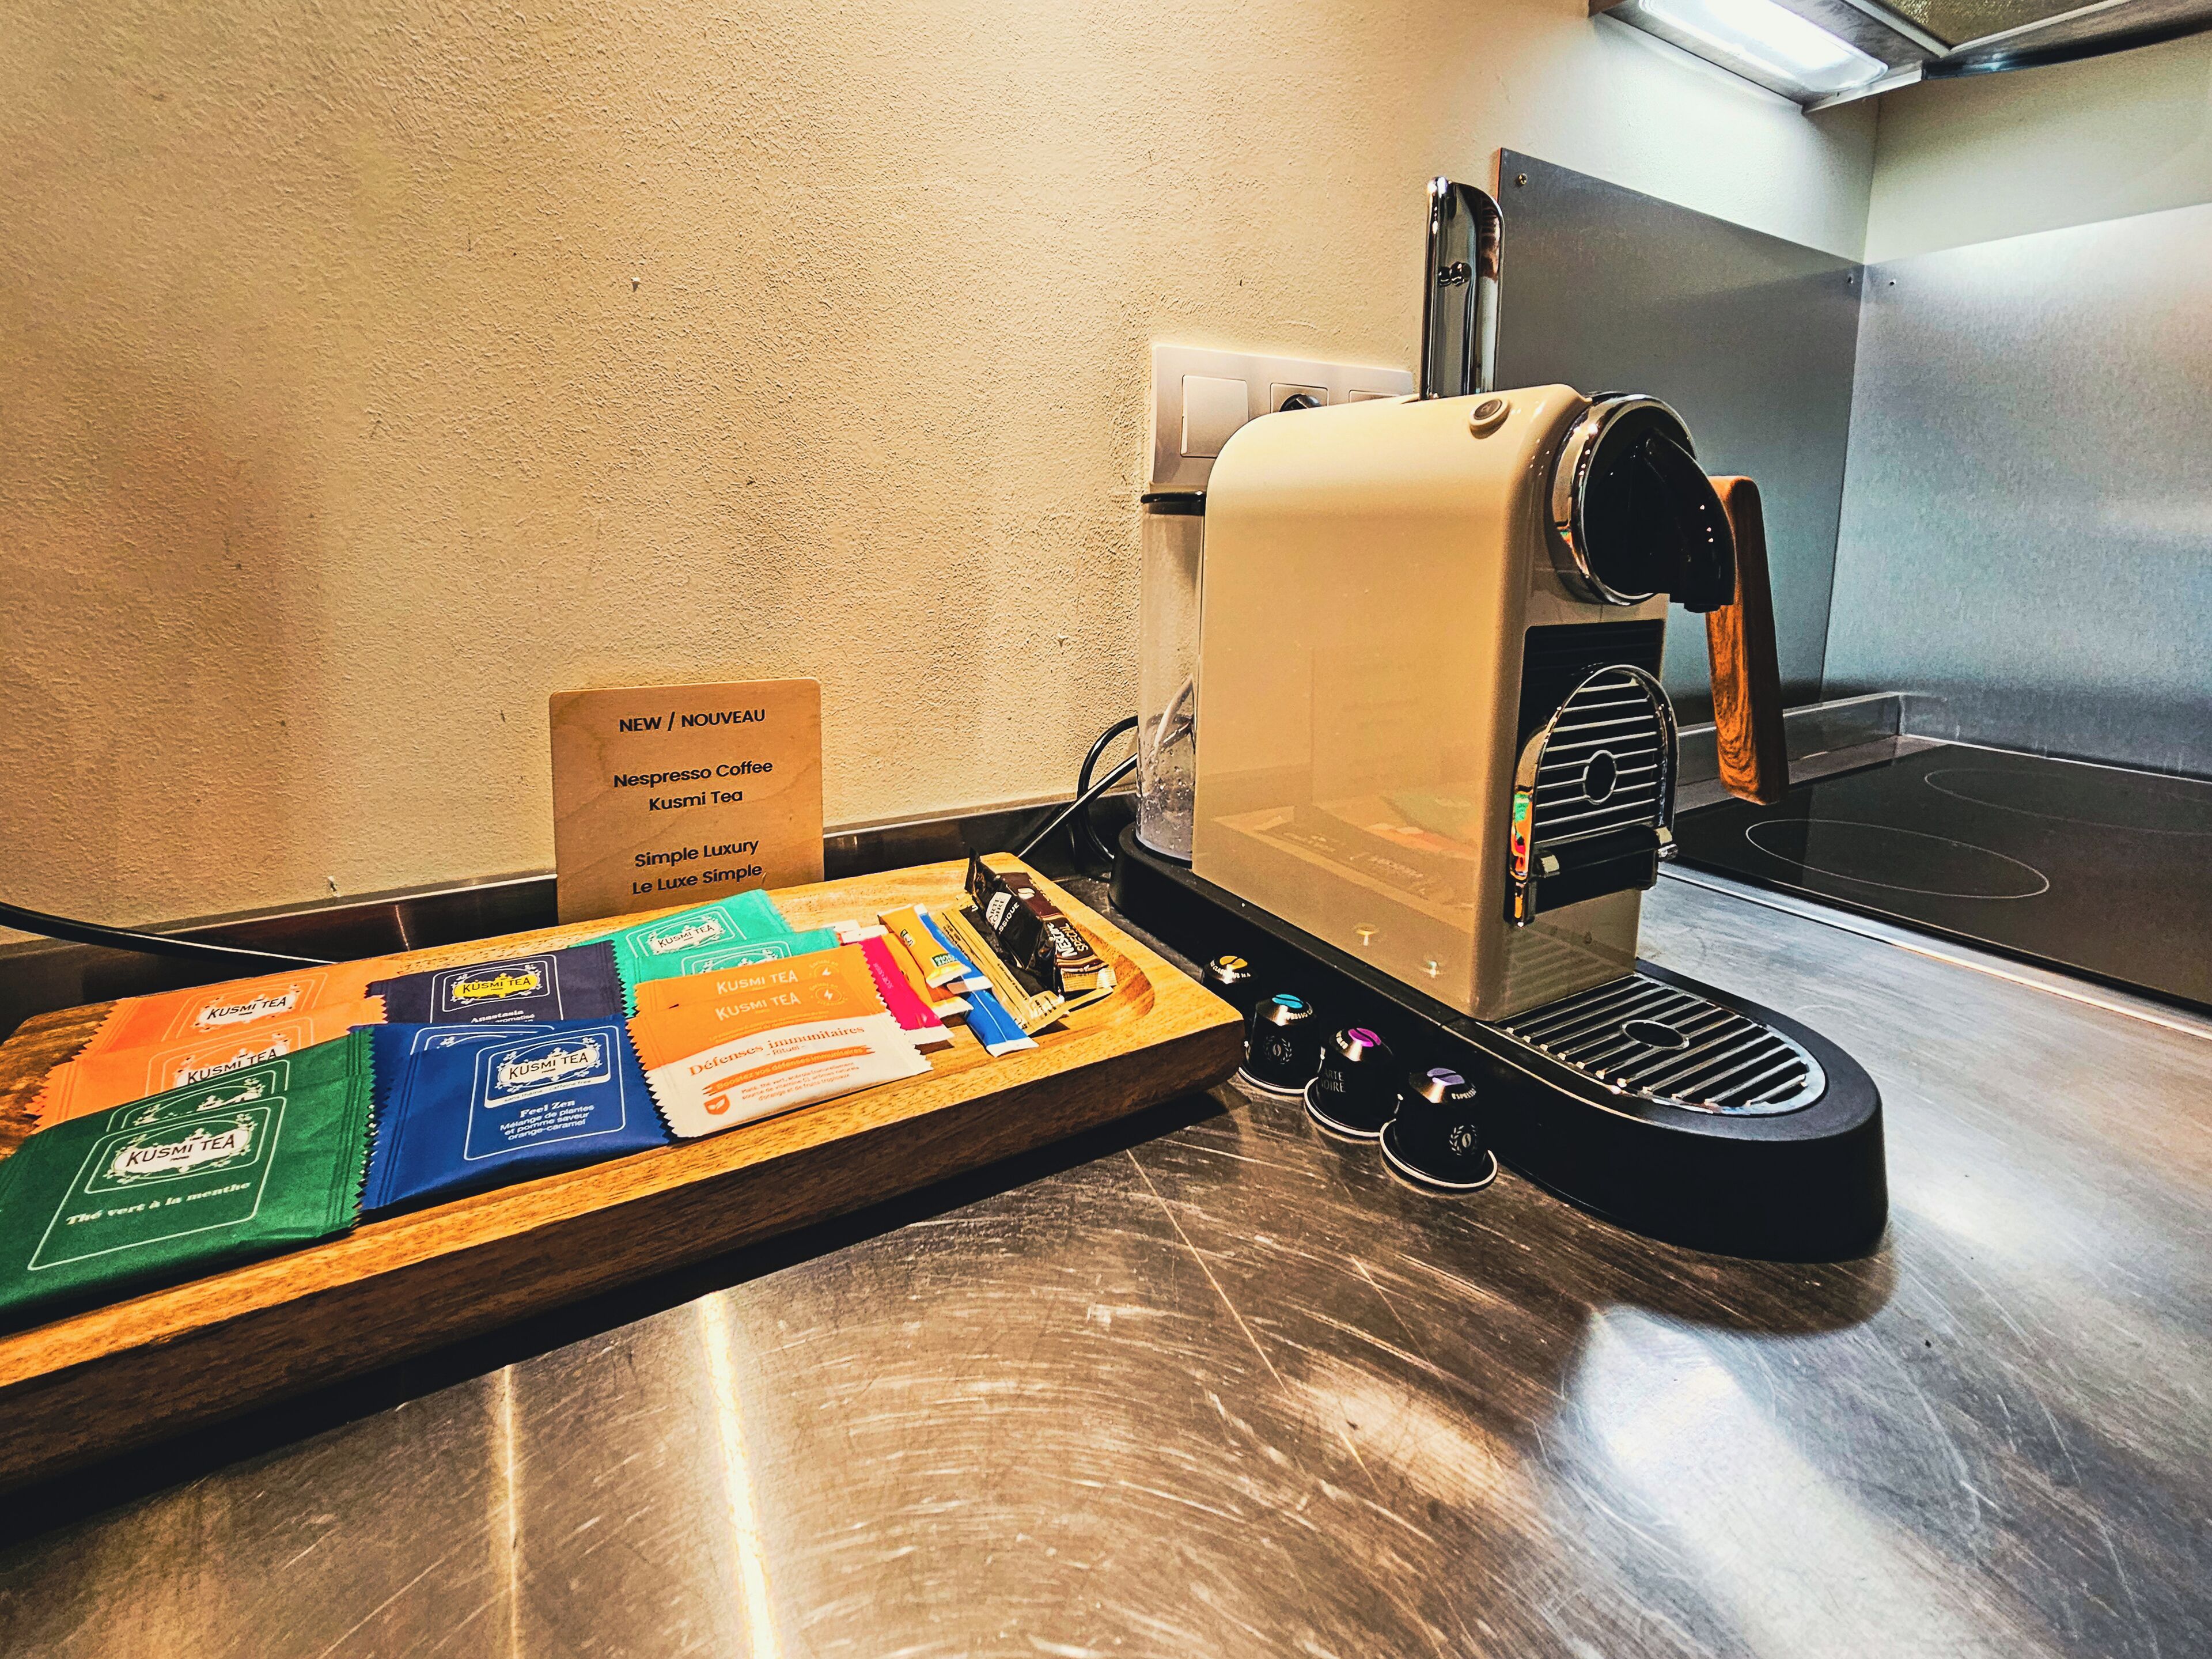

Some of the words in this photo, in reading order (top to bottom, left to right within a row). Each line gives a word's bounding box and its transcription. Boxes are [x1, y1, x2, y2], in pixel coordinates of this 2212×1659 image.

[619, 717, 662, 732] NEW
[667, 711, 675, 731] /
[681, 709, 766, 728] NOUVEAU
[613, 768, 712, 788] Nespresso
[716, 760, 773, 777] Coffee
[649, 791, 706, 811] Kusmi
[710, 791, 743, 804] Tea
[635, 847, 699, 867] Simple
[703, 840, 759, 857] Luxury
[632, 882, 653, 895] Le
[658, 876, 698, 891] Luxe
[702, 864, 763, 884] Simple
[998, 902, 1020, 933] SSIQUE
[658, 931, 692, 948] KUSMI
[695, 925, 714, 935] TEA
[463, 982, 503, 994] KUSMI
[506, 977, 531, 986] TEA
[717, 976, 766, 994] KUSMI
[770, 969, 798, 983] TEA
[207, 1003, 257, 1020] KUSMI
[262, 997, 287, 1009] TEA
[471, 1010, 524, 1023] Anastasia
[715, 999, 767, 1021] KUSMI
[770, 992, 801, 1006] TEA
[688, 1046, 763, 1075] Défenses
[767, 1027, 865, 1048] immunitaires
[772, 1045, 800, 1055] Rituel
[187, 1060, 241, 1085] KUSMI
[247, 1048, 277, 1065] TEA
[509, 1059, 556, 1080] KUSMI
[561, 1052, 588, 1065] TEA
[717, 1073, 753, 1089] Boostez
[772, 1058, 810, 1071] défenses
[811, 1048, 863, 1060] immunitaires
[1324, 1068, 1344, 1081] ARTE
[500, 1115, 543, 1131] Mélange
[559, 1105, 594, 1116] plantes
[520, 1104, 548, 1118] Feel
[551, 1100, 575, 1109] Zen
[507, 1118, 586, 1141] orange-caramel
[517, 1119, 555, 1133] pomme
[557, 1112, 589, 1123] saveur
[126, 1144, 194, 1167] KUSMI
[200, 1134, 235, 1151] TEA
[66, 1210, 103, 1225] Thé
[107, 1203, 146, 1217] vert
[148, 1200, 161, 1209] à
[165, 1196, 183, 1206] la
[186, 1182, 252, 1202] menthe
